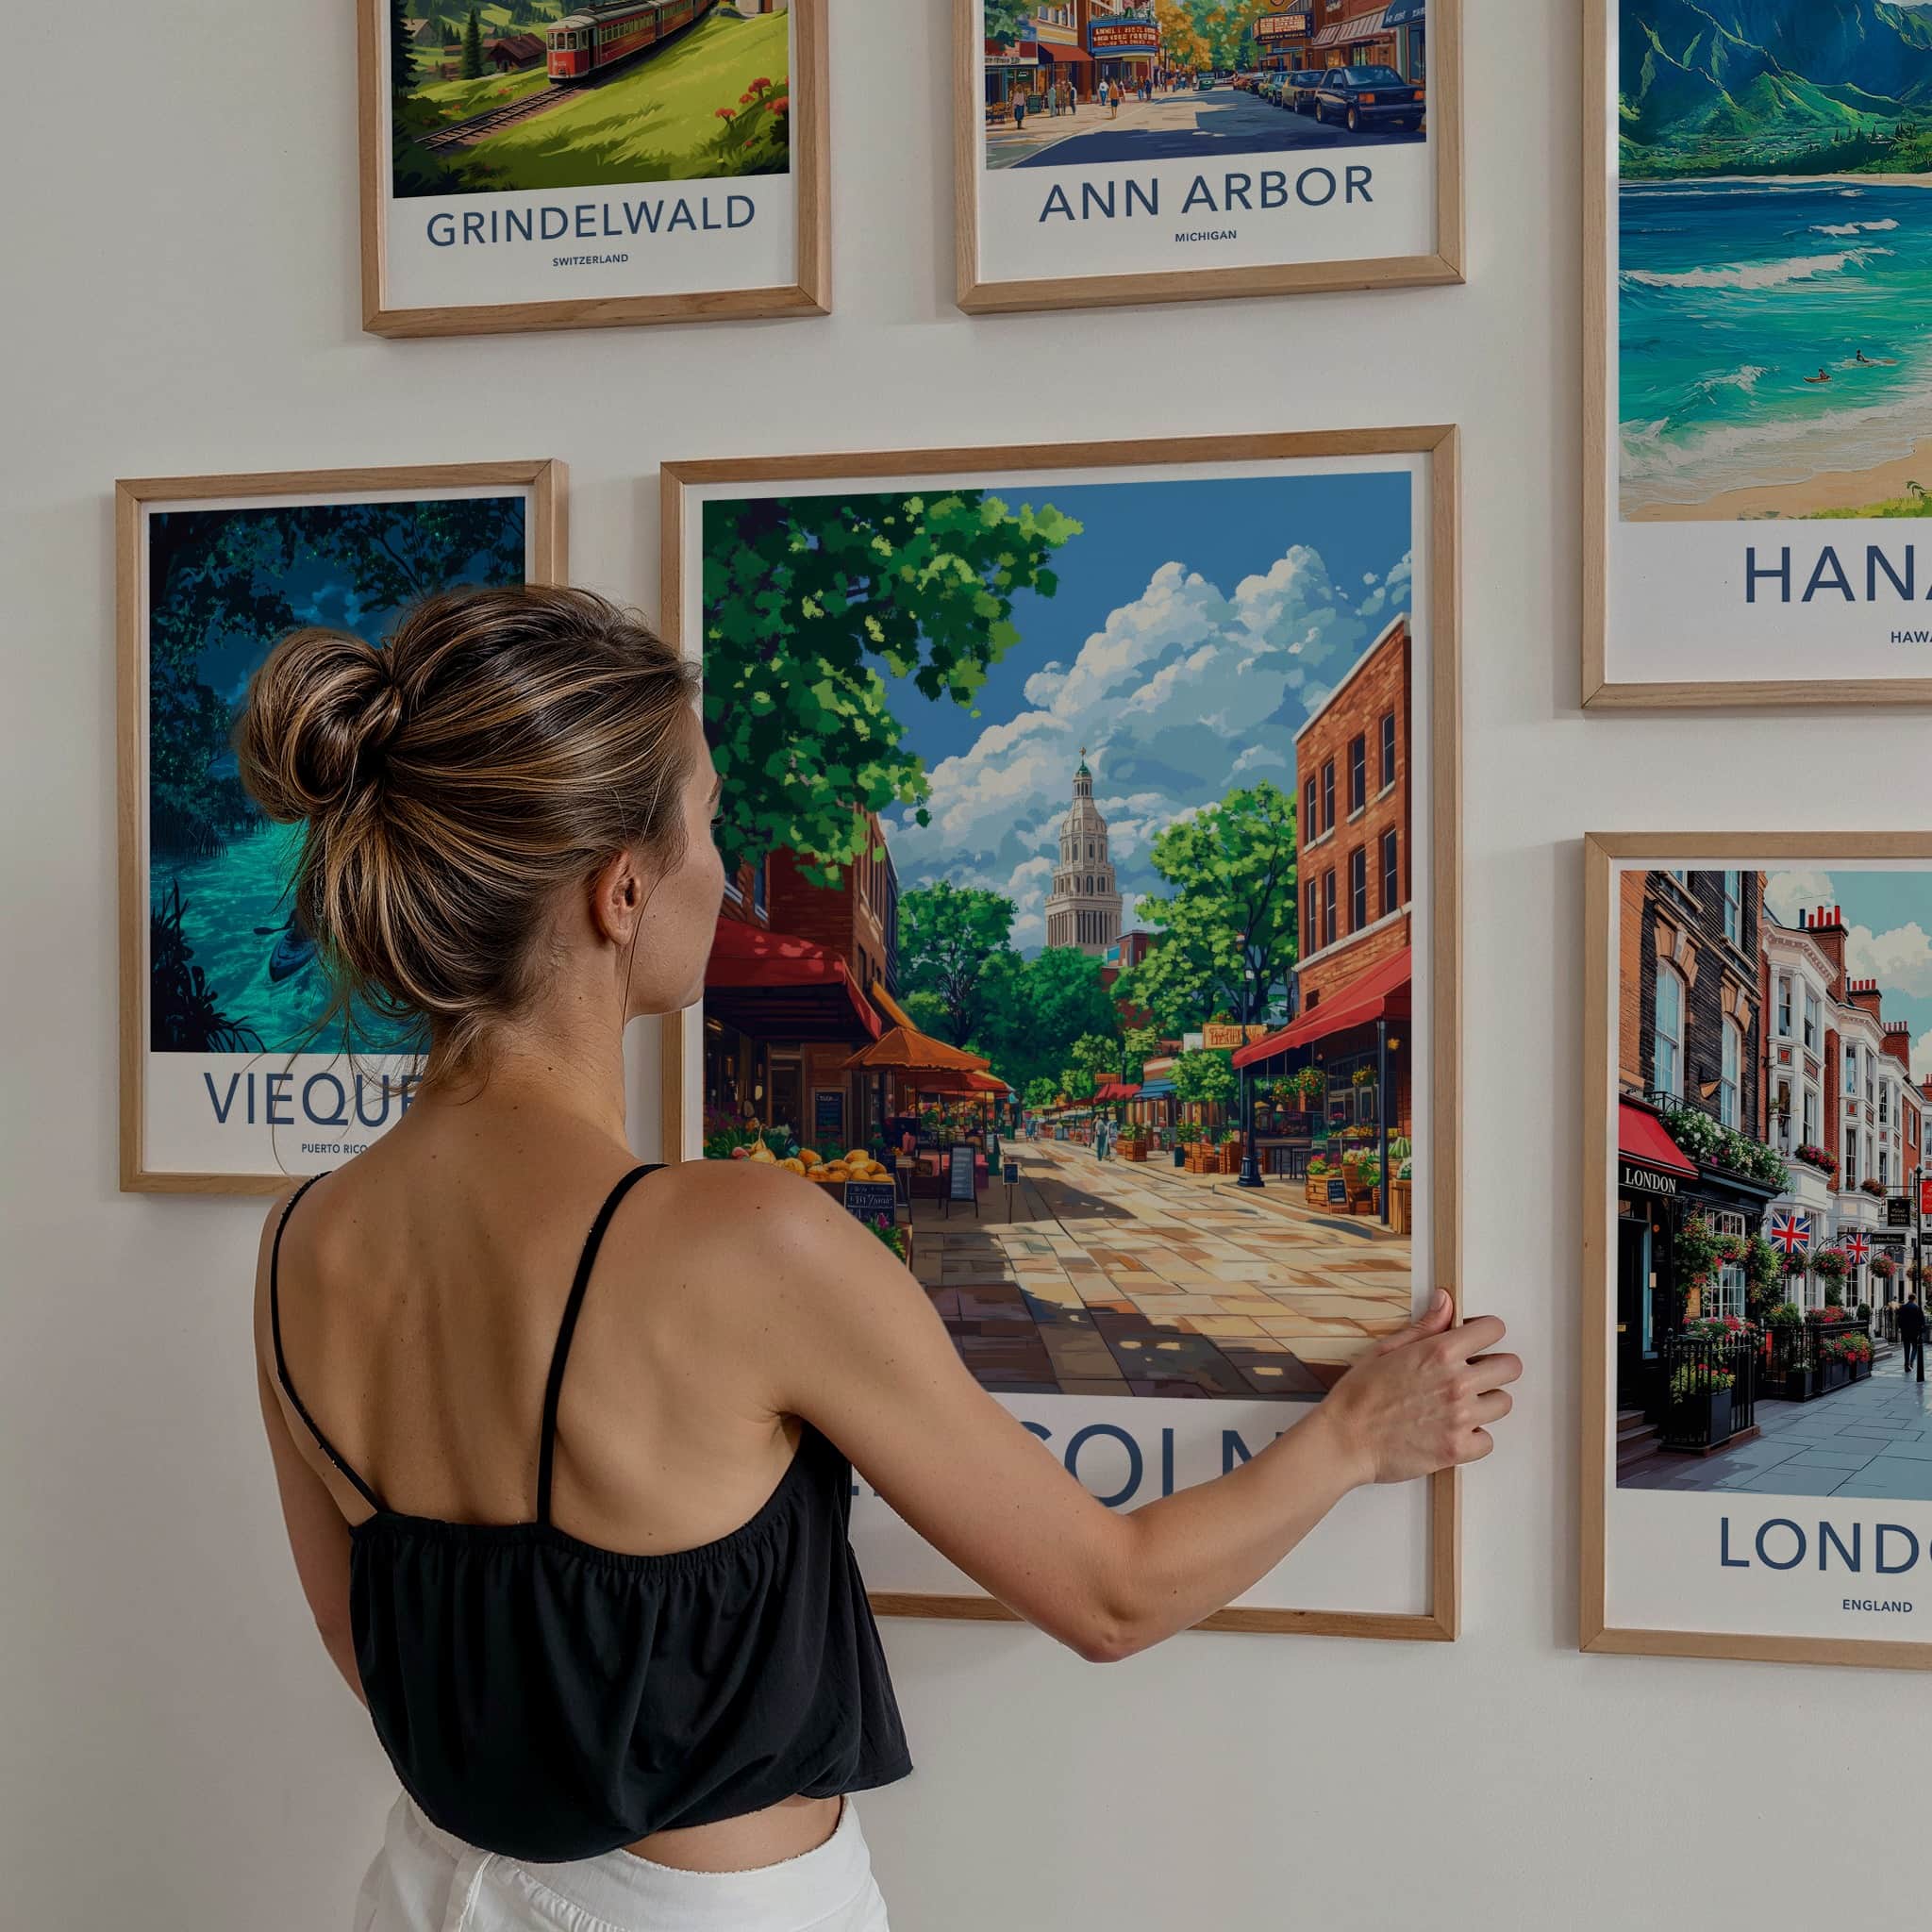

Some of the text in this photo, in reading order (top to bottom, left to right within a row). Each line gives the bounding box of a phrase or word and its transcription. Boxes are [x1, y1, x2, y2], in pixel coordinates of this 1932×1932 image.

[1039, 165, 1374, 223] ANN ARBOR
[426, 194, 755, 247] GRINDELWALD
[1174, 229, 1238, 242] MICHIGAN
[552, 254, 629, 267] SWITZERLAND
[1745, 544, 1932, 603] HAN
[1890, 630, 1932, 643] HAW
[203, 1072, 424, 1127] VIEQUE
[301, 1143, 368, 1156] PUERTO RICO
[1624, 1166, 1676, 1194] LONDON
[1721, 1516, 1932, 1574] LOND
[1842, 1599, 1913, 1613] ENGLAND
